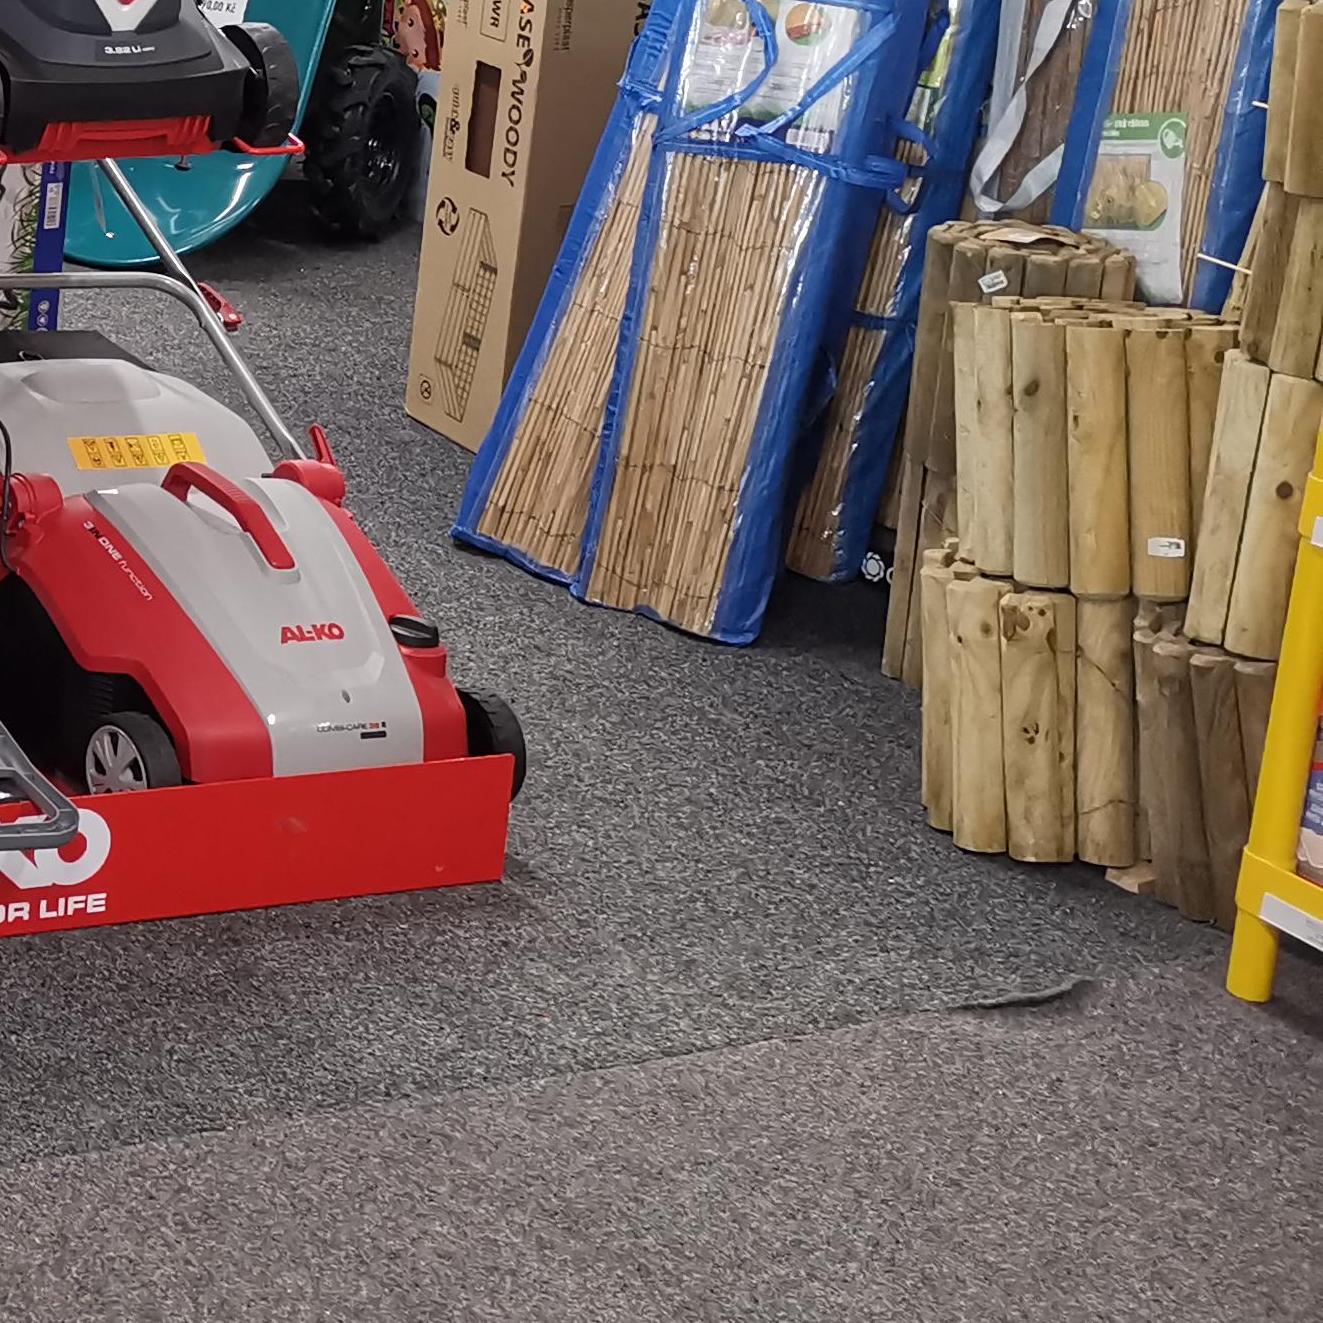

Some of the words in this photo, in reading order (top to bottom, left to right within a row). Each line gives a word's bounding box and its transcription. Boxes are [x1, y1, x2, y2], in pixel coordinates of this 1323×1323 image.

[501, 75, 528, 188] WOODY
[280, 622, 345, 645] AL-KO
[39, 892, 107, 919] LIFE
